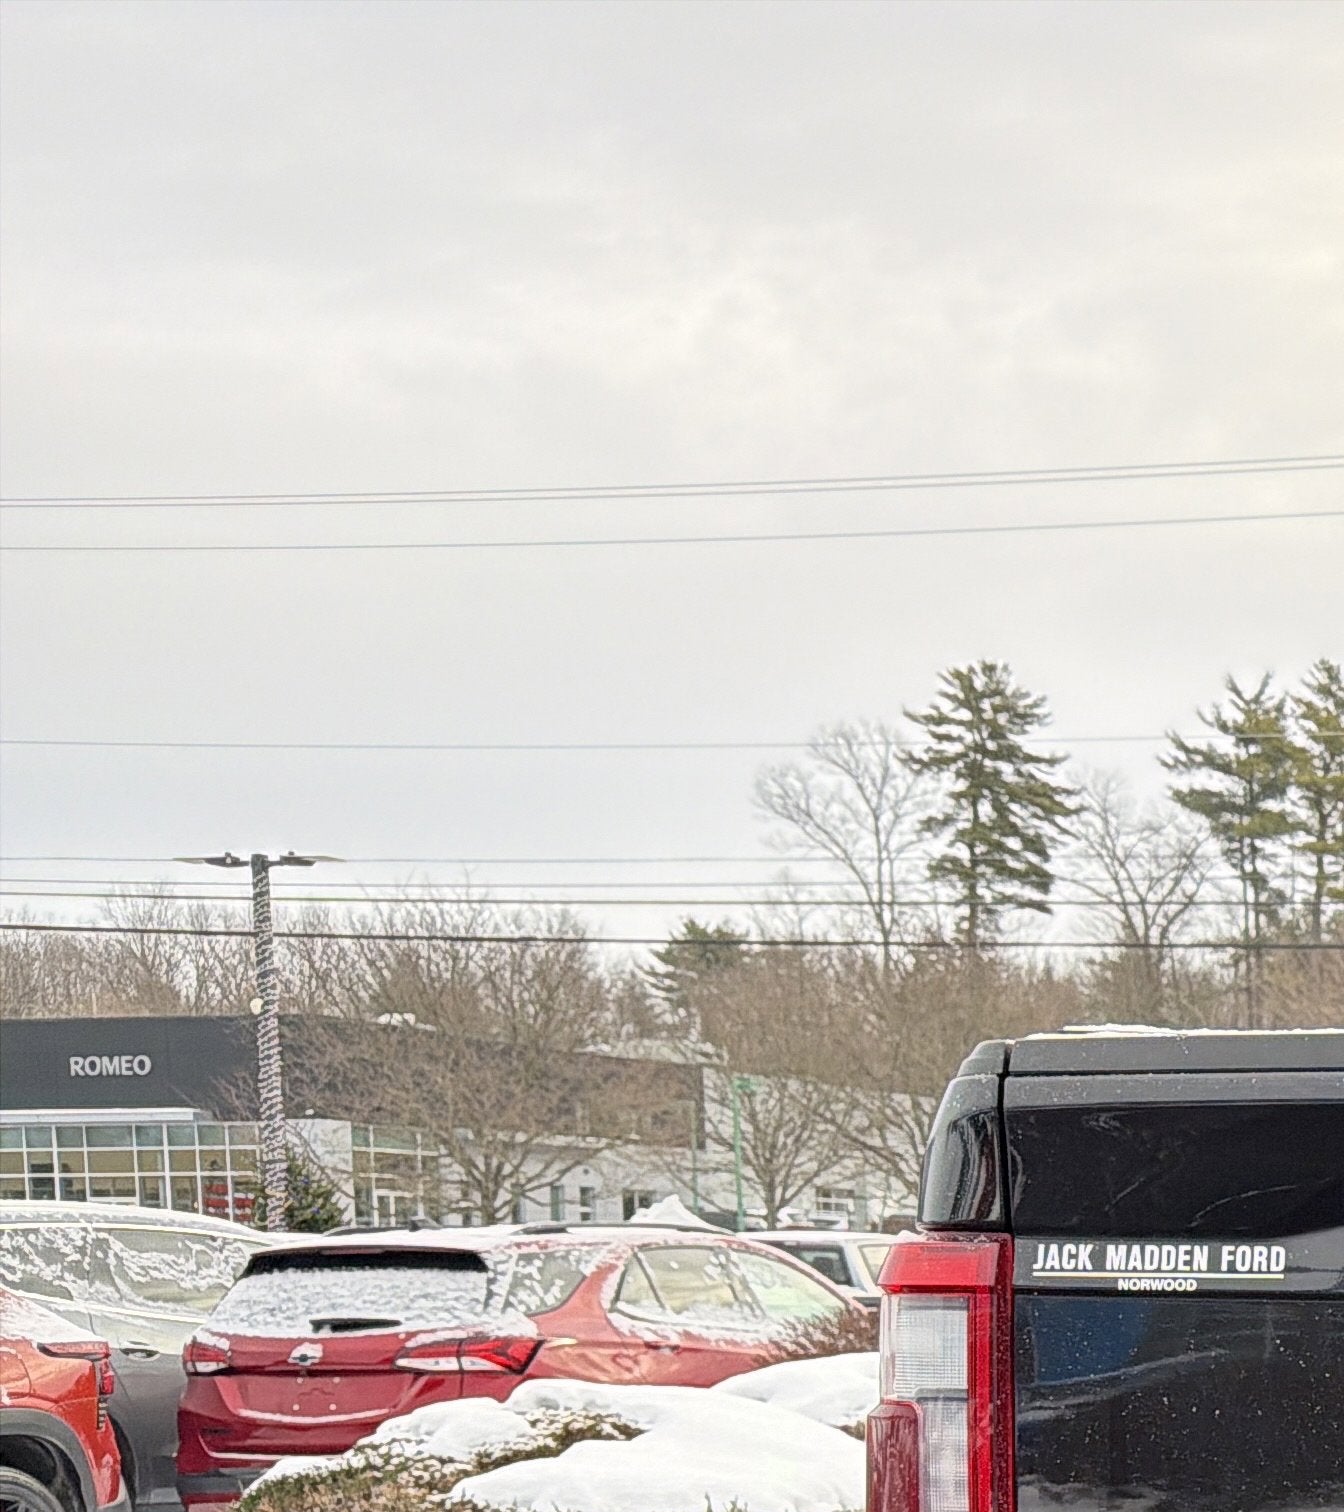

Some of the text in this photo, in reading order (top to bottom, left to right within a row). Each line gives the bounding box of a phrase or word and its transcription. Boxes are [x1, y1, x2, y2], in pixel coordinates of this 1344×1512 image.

[69, 1054, 152, 1077] ROMEO
[1033, 1243, 1286, 1272] JACK MADDEN FORD
[1117, 1278, 1198, 1292] NORWOOD
